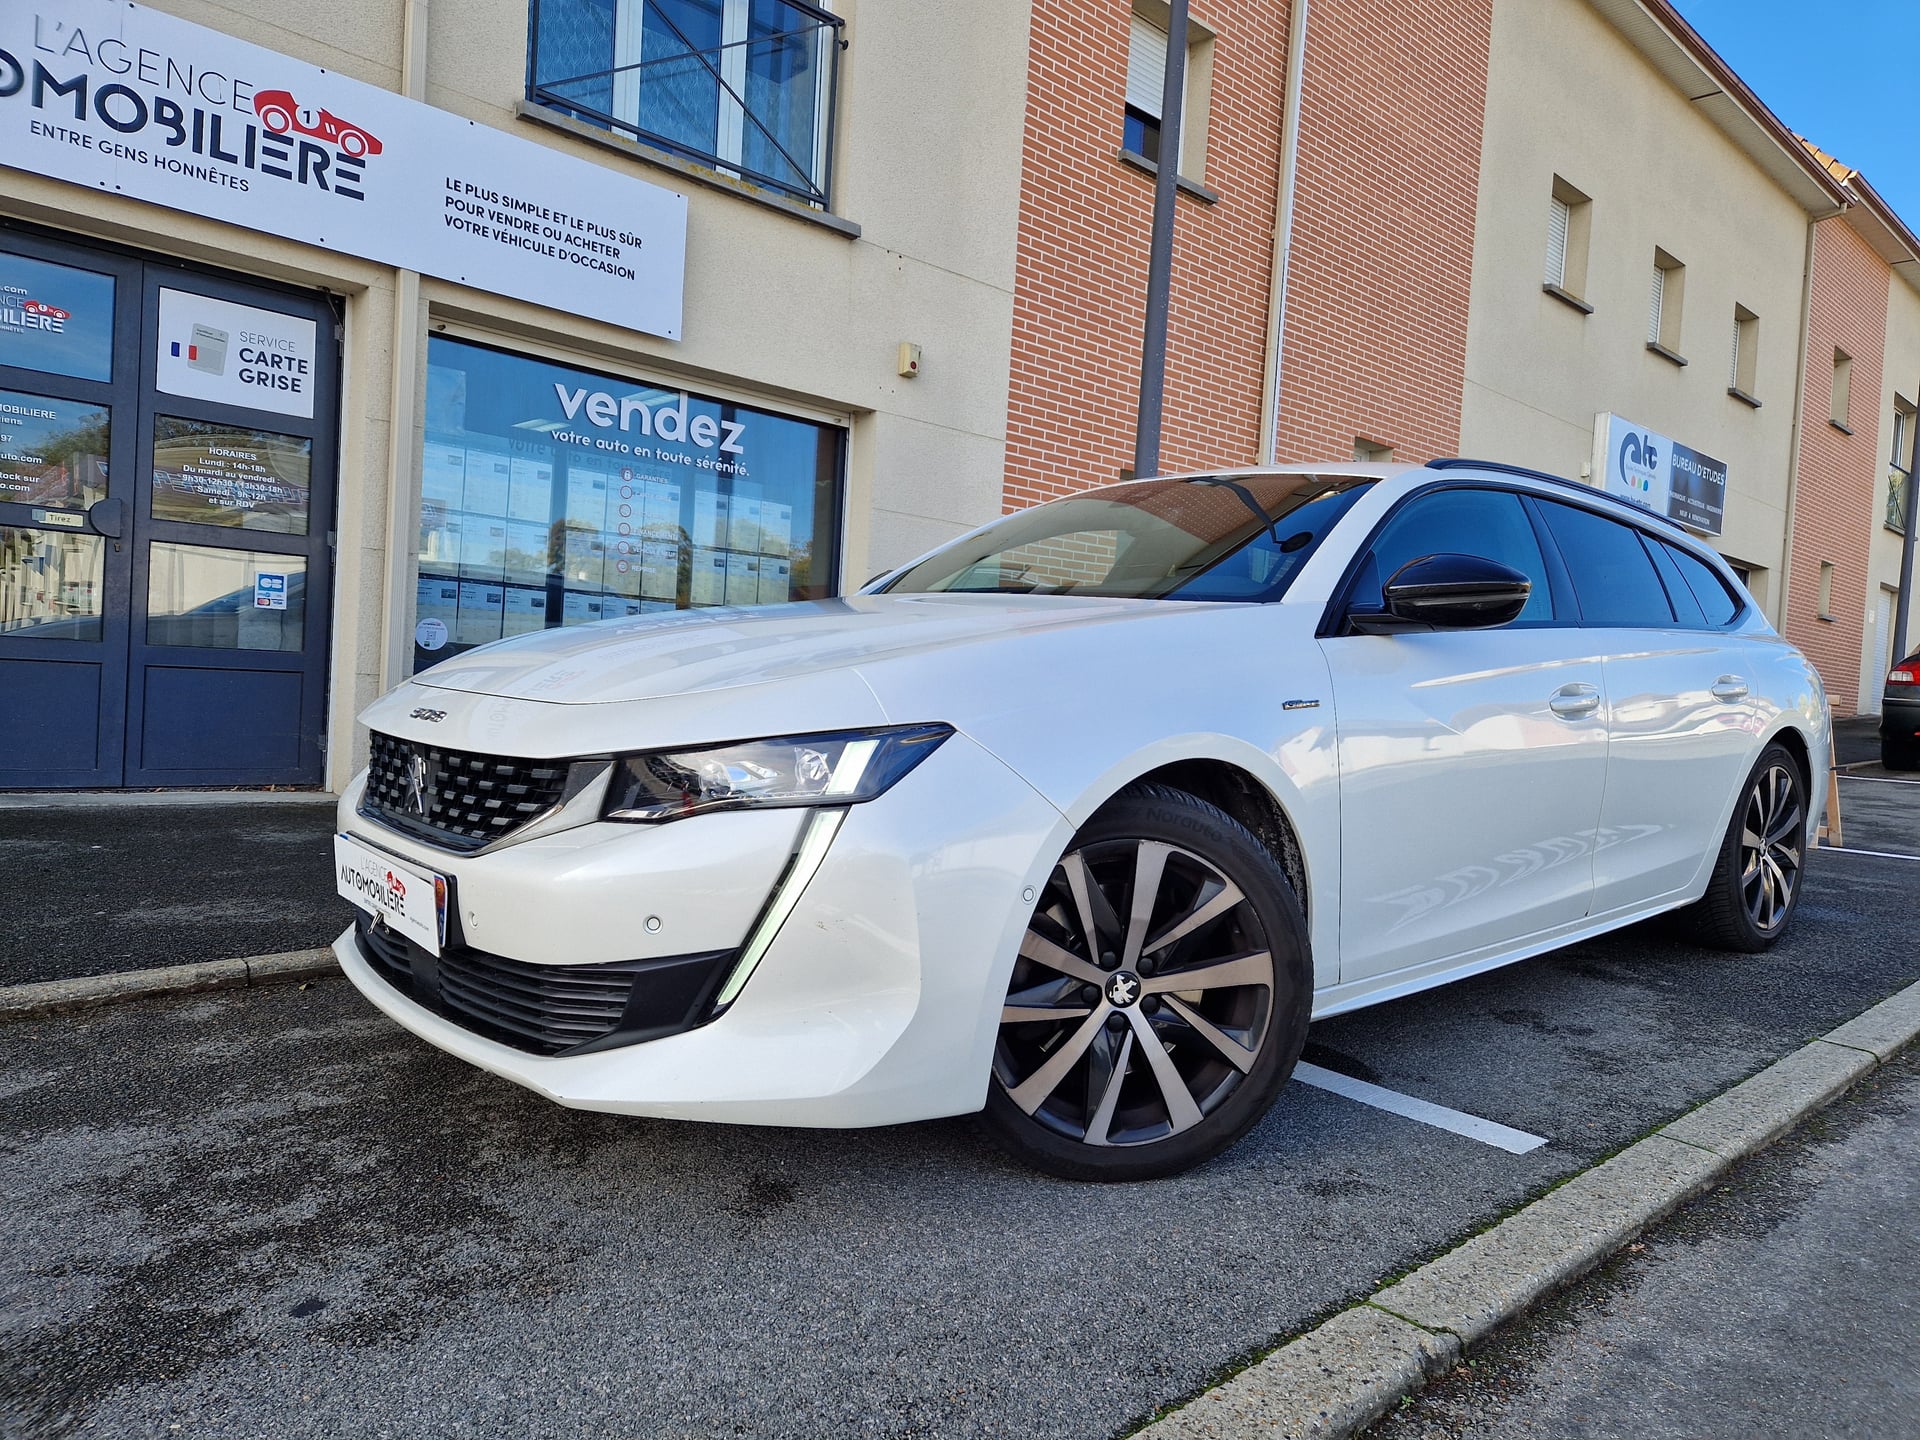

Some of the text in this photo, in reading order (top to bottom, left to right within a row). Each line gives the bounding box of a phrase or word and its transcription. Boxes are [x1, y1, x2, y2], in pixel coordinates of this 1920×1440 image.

[34, 14, 254, 115] L'AGENCE
[303, 109, 311, 124] 1
[30, 120, 250, 192] ENTRE GENS HONNÊTES
[446, 177, 642, 249] LE PLUS SIMPLE ET LE PLUS SÛR
[445, 196, 621, 260] POUR VENDRE OU ACHETER
[444, 214, 635, 281] VOTRE VÉHICULE D'OCCASION
[0, 308, 64, 333] ILIERE
[240, 331, 295, 353] SERVICE
[239, 348, 308, 375] CARTE
[239, 368, 301, 393] GRISE
[0, 416, 22, 425] iens
[554, 383, 746, 455] vendez
[199, 457, 224, 467] Lundi
[232, 462, 266, 473] 14h-18h
[209, 447, 257, 461] HORAIRES
[551, 430, 591, 446] votre
[595, 438, 629, 454] auto
[634, 446, 651, 457] en
[655, 448, 692, 466] toute
[695, 454, 750, 477] sérénité.
[183, 464, 195, 473] Du
[198, 467, 223, 476] mardi
[238, 473, 275, 484] vendredi
[1672, 454, 1697, 474] BUREAU
[1697, 464, 1725, 486] D'ETUDES
[197, 485, 230, 496] Samedi
[209, 497, 255, 509] et sur RDV
[50, 514, 71, 523] Tirez
[1146, 808, 1222, 842] Norauto
[340, 864, 405, 917] AUTOMOBILIERE
